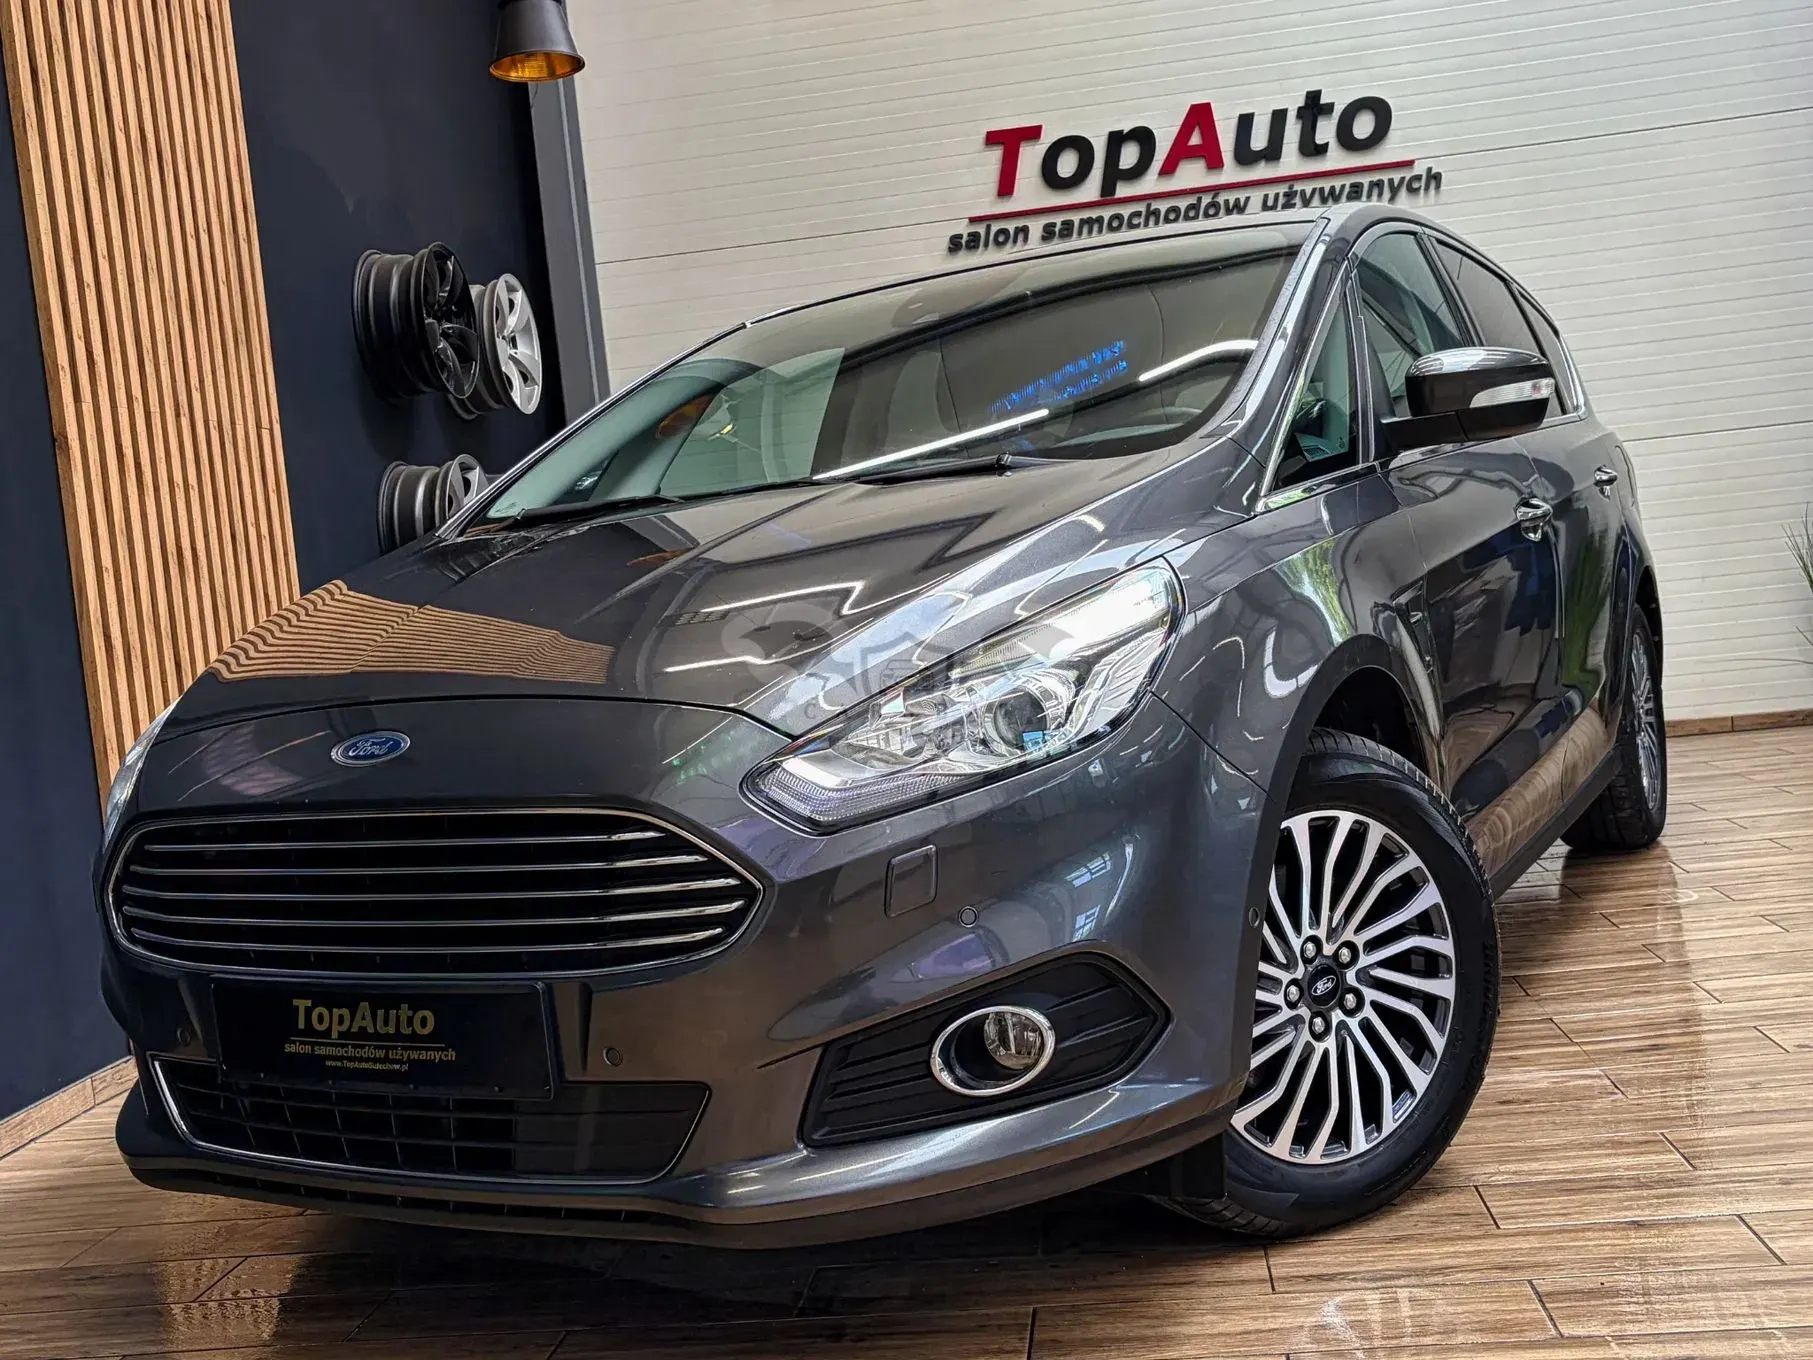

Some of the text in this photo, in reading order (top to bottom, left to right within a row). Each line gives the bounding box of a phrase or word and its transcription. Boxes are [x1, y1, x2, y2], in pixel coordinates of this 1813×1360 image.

[984, 89, 1393, 198] TopAuto
[948, 167, 1443, 254] salon samochodów używanych
[348, 737, 394, 756] Ford
[292, 999, 435, 1039] TopAuto
[284, 1041, 456, 1062] salon samochodów używanych
